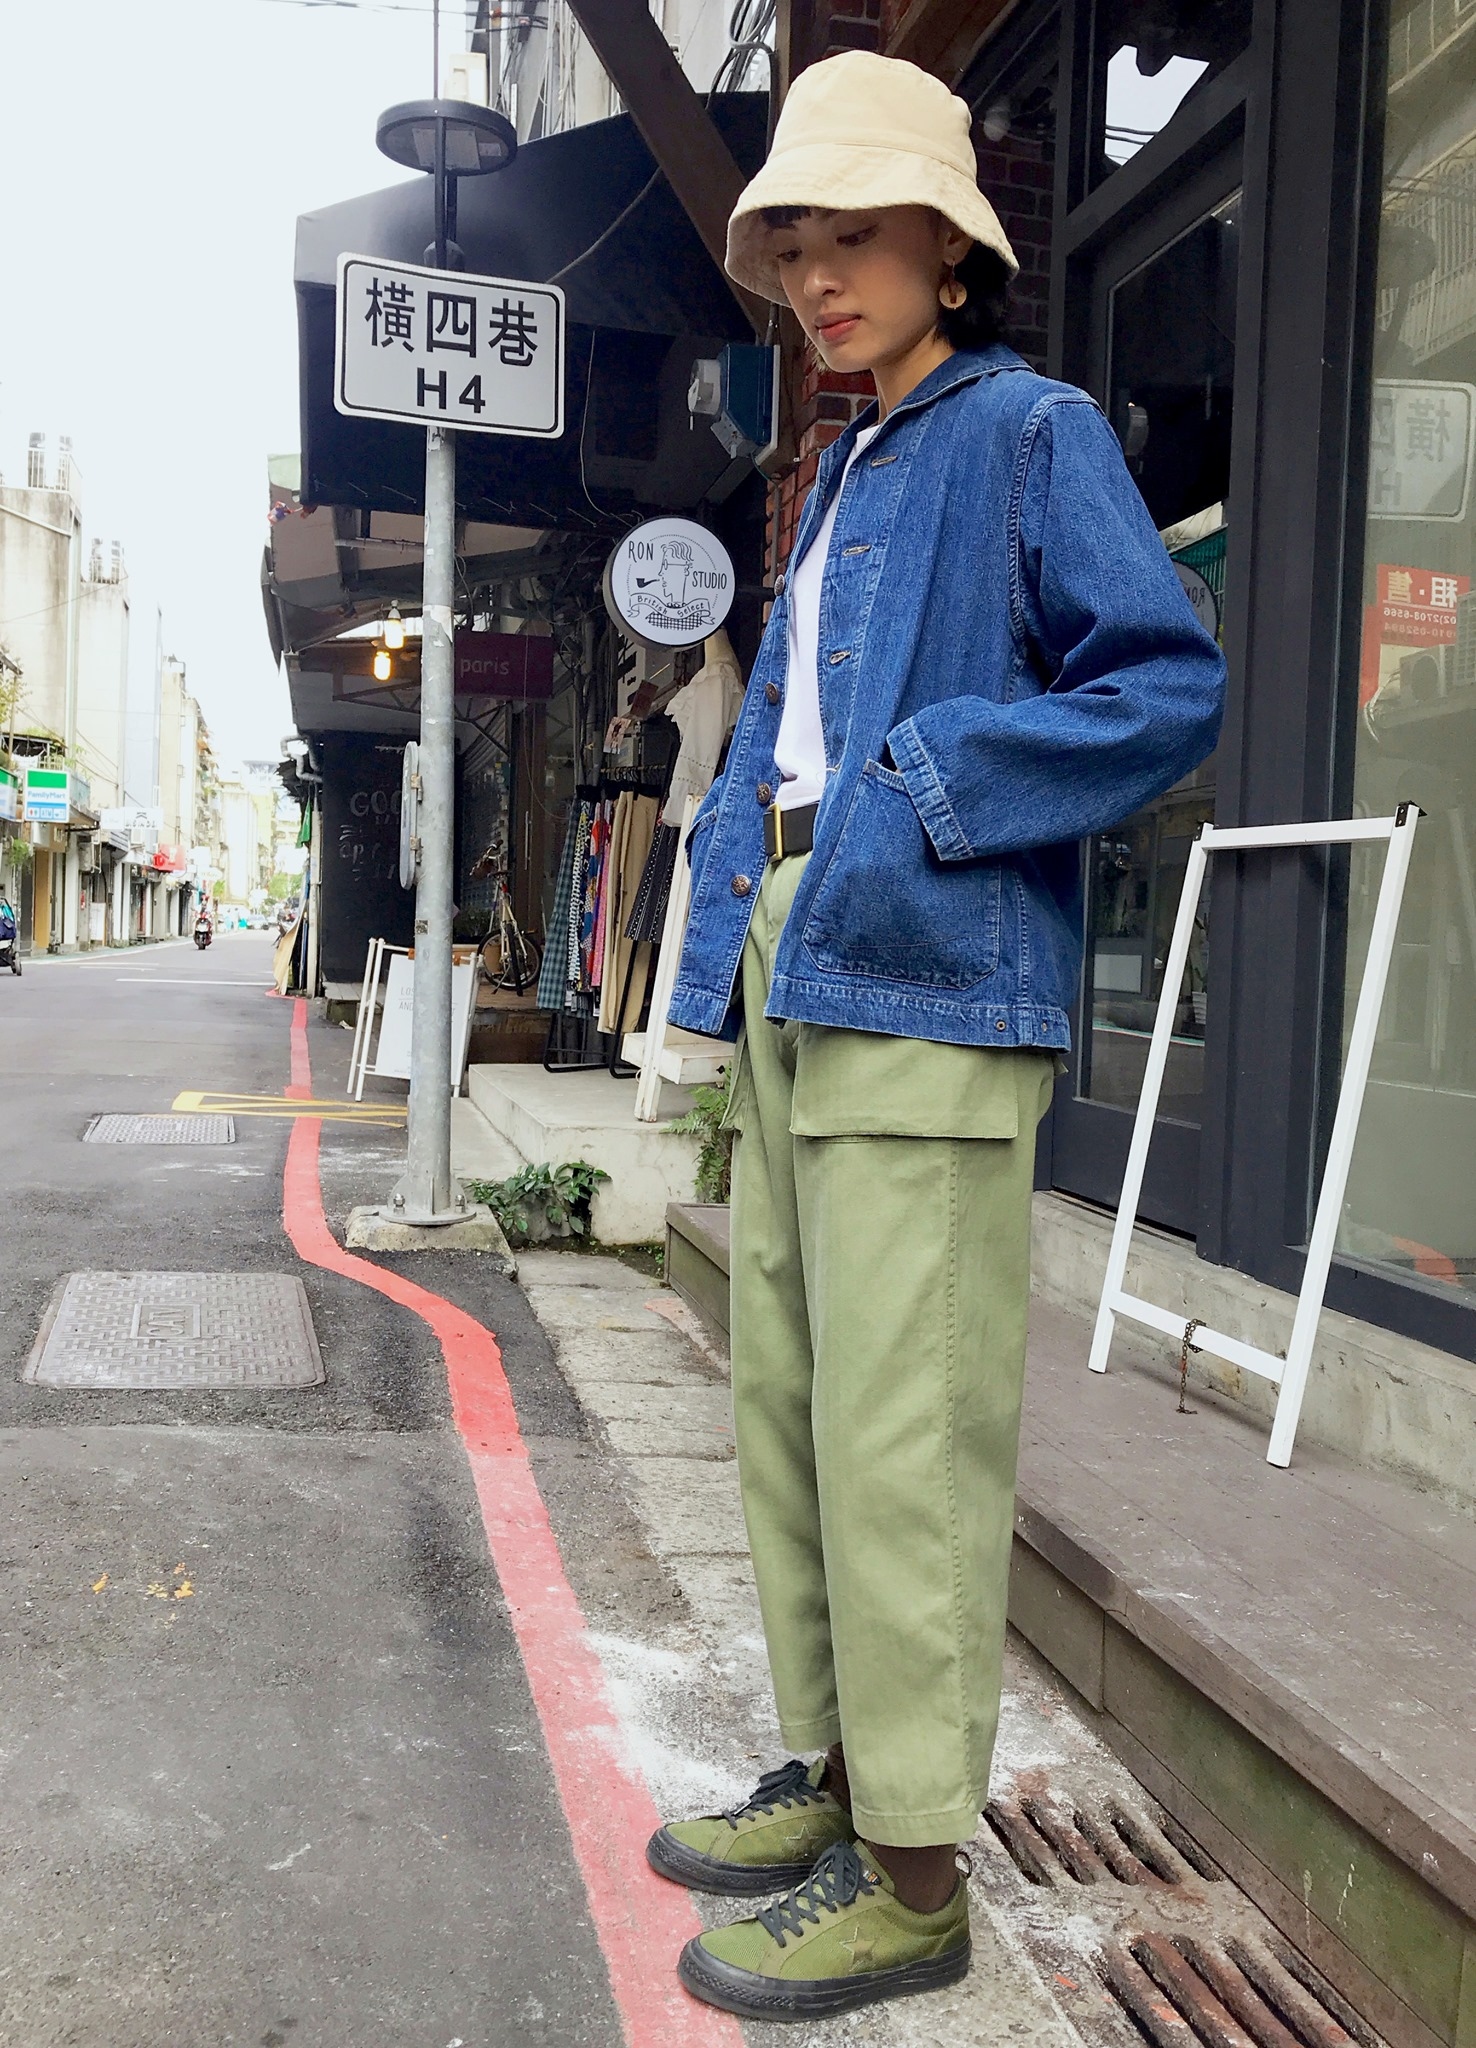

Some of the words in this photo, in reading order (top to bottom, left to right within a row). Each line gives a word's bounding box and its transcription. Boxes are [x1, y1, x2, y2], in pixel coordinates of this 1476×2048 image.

[364, 277, 538, 367] 橫四巷
[417, 367, 486, 414] H4
[628, 540, 654, 563] RON
[692, 570, 728, 590] STUDIO
[637, 595, 668, 615] British
[677, 602, 705, 617] Select
[460, 657, 510, 678] paris
